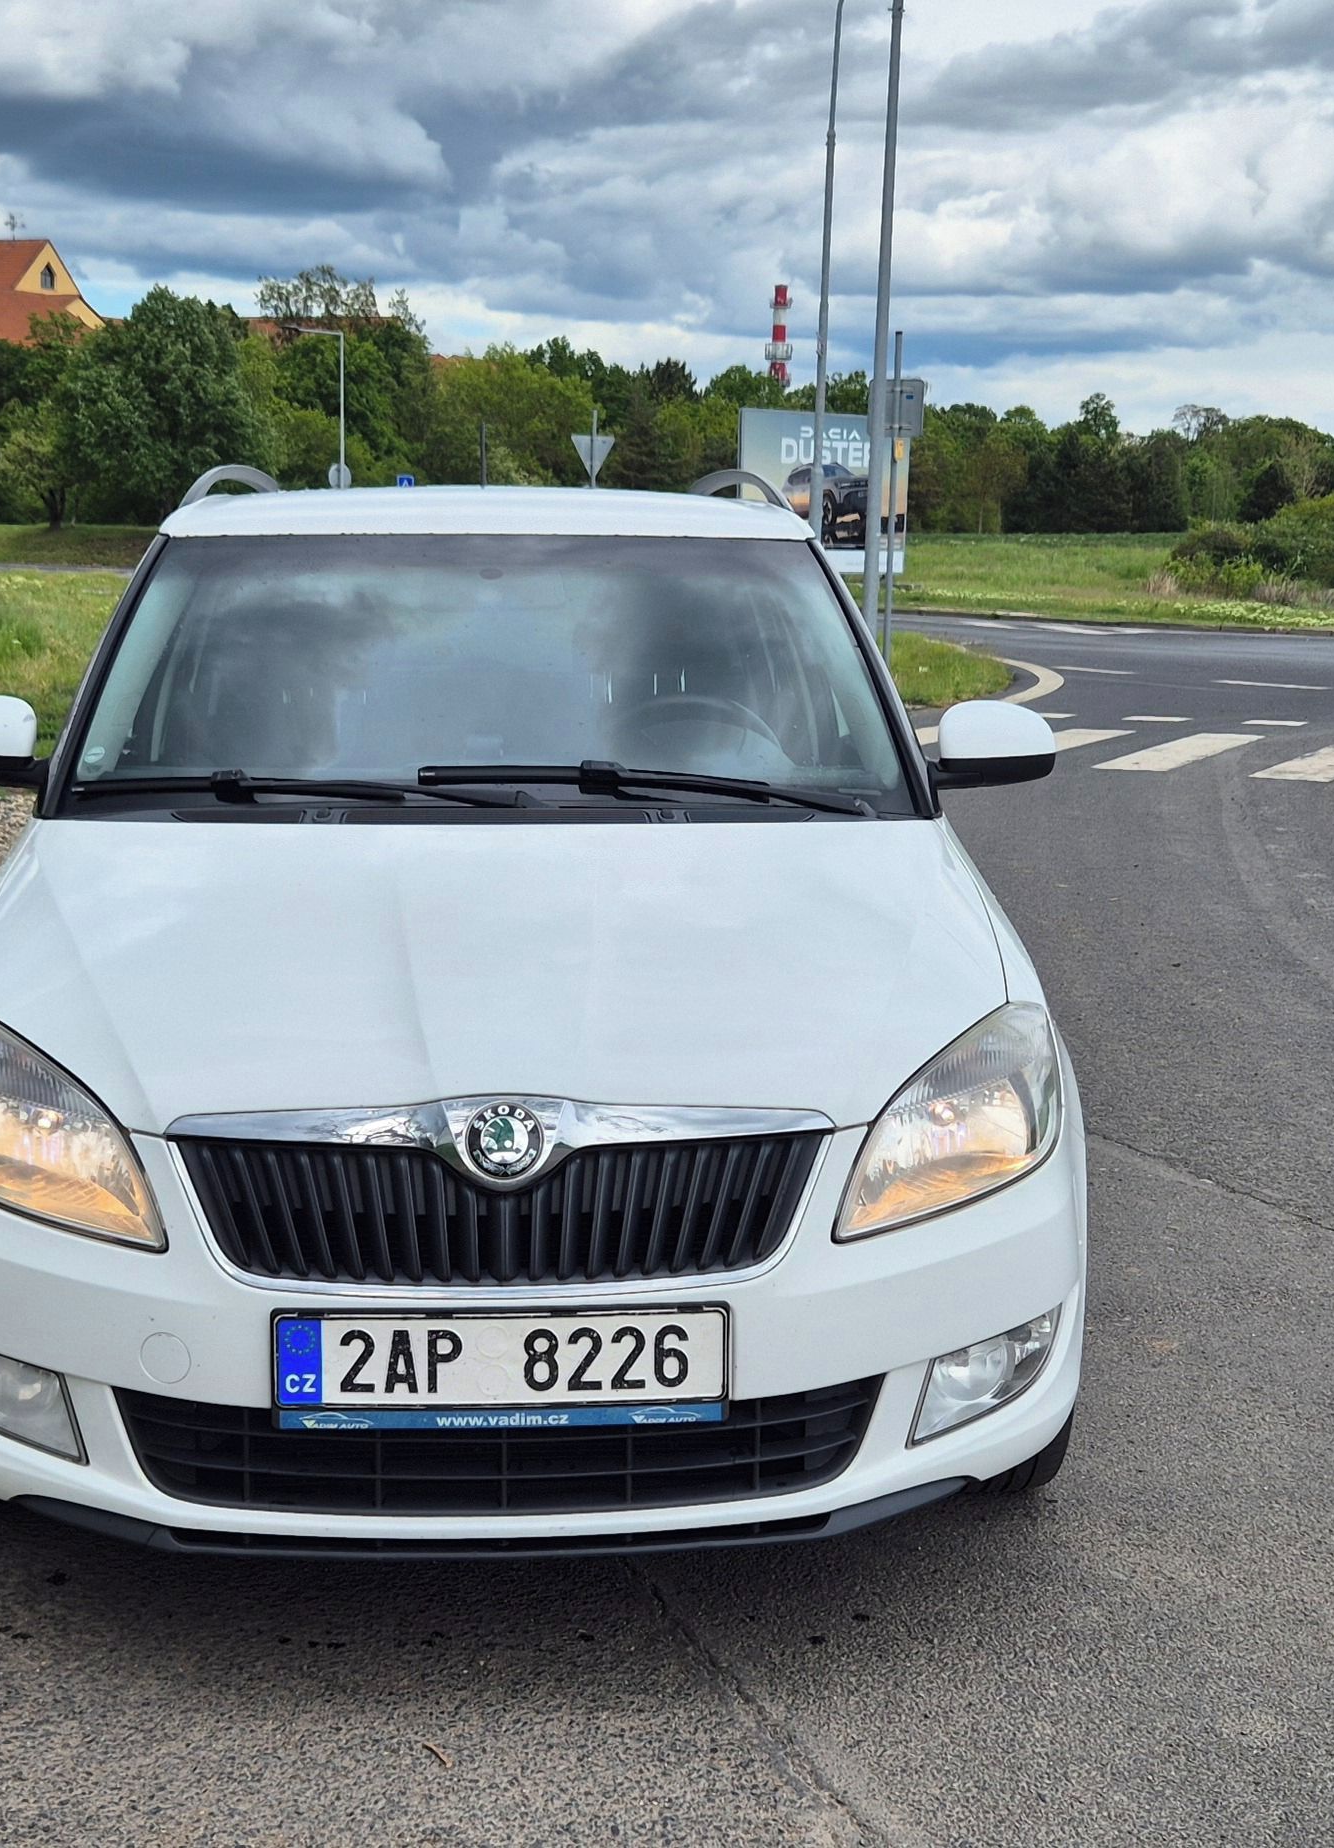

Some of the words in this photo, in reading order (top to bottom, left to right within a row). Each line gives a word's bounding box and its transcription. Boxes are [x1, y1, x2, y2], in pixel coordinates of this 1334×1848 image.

[339, 1329, 463, 1394] 2AP
[524, 1324, 690, 1391] 8226
[285, 1373, 317, 1393] CZ
[338, 1422, 369, 1430] AUTO
[435, 1412, 570, 1427] www.vadim.cz
